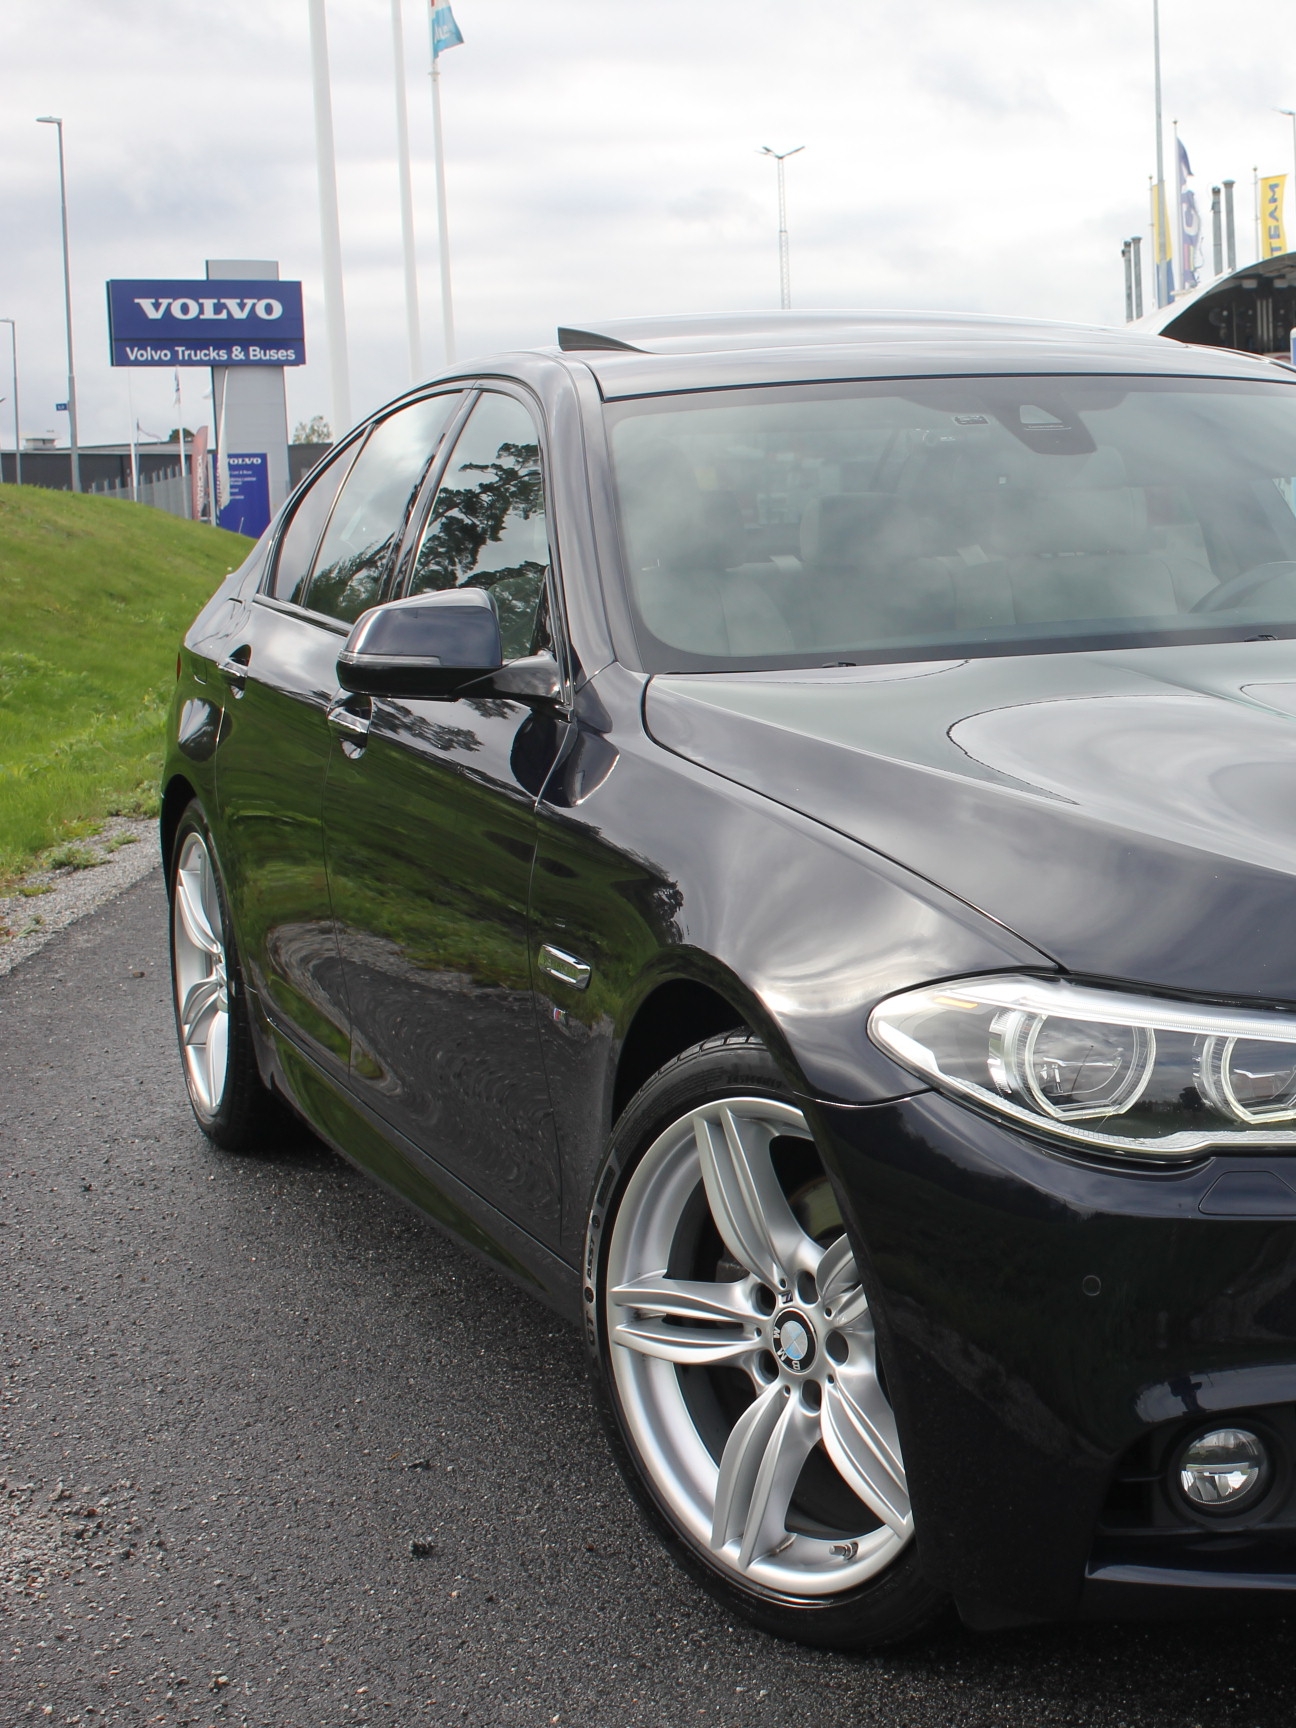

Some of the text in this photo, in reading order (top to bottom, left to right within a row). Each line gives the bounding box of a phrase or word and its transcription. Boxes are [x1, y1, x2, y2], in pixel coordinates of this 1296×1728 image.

[1268, 183, 1282, 257] TEAM
[134, 298, 283, 320] VOLVO
[125, 345, 296, 361] Volvo Trucks & Buses
[228, 457, 262, 465] OLVO
[773, 1327, 801, 1371] BMW
